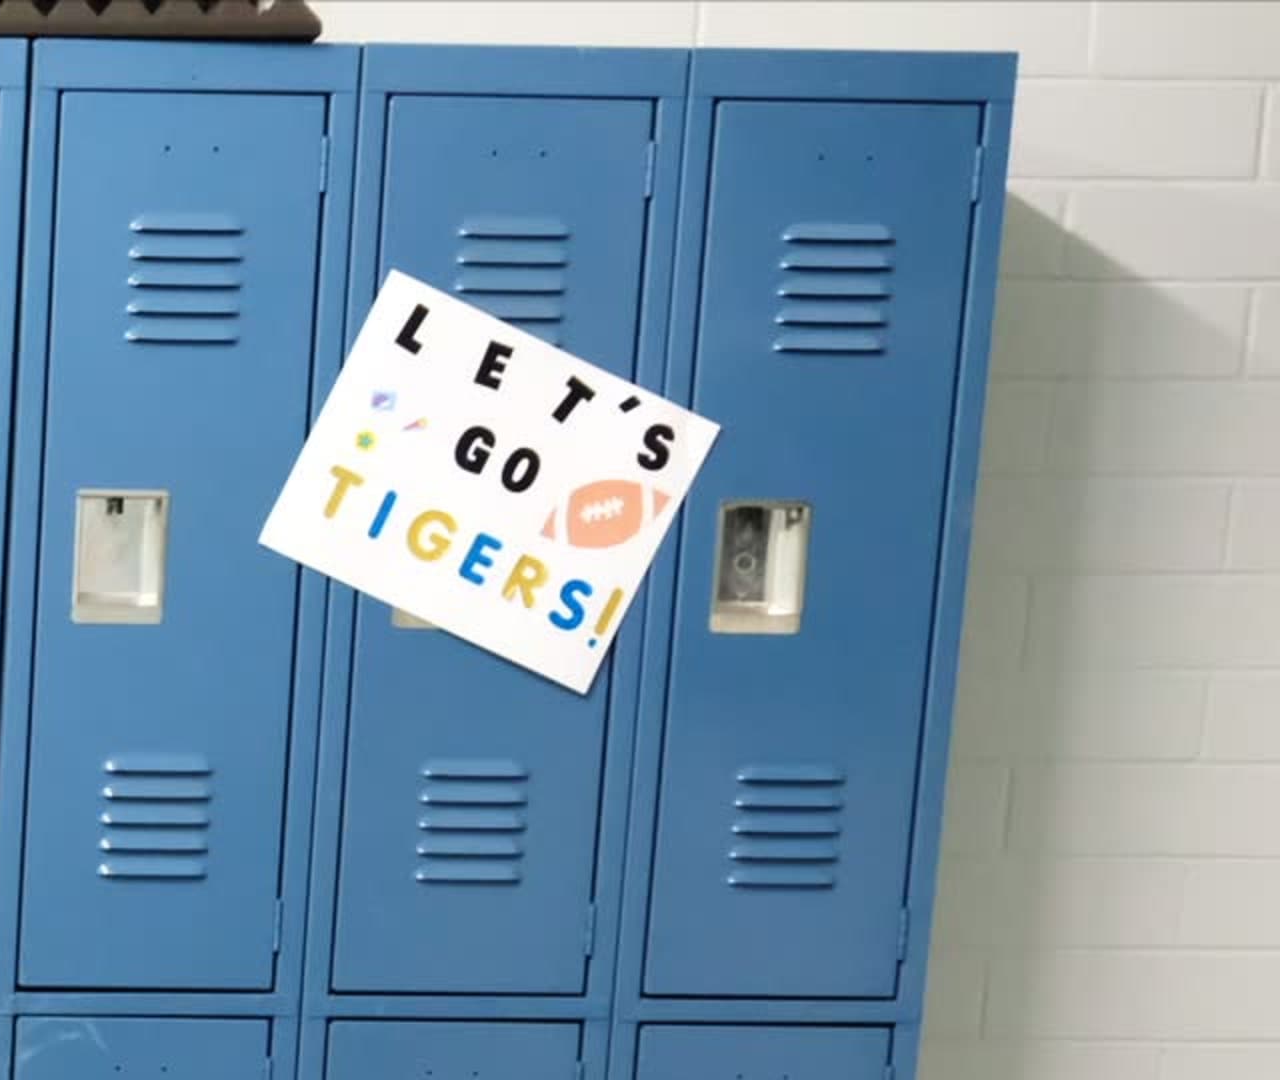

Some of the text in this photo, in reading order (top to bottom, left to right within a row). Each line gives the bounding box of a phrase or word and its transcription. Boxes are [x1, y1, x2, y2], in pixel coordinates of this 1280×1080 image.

[394, 303, 675, 471] LET'S
[454, 425, 541, 493] GO
[323, 464, 624, 647] TIGERS!
